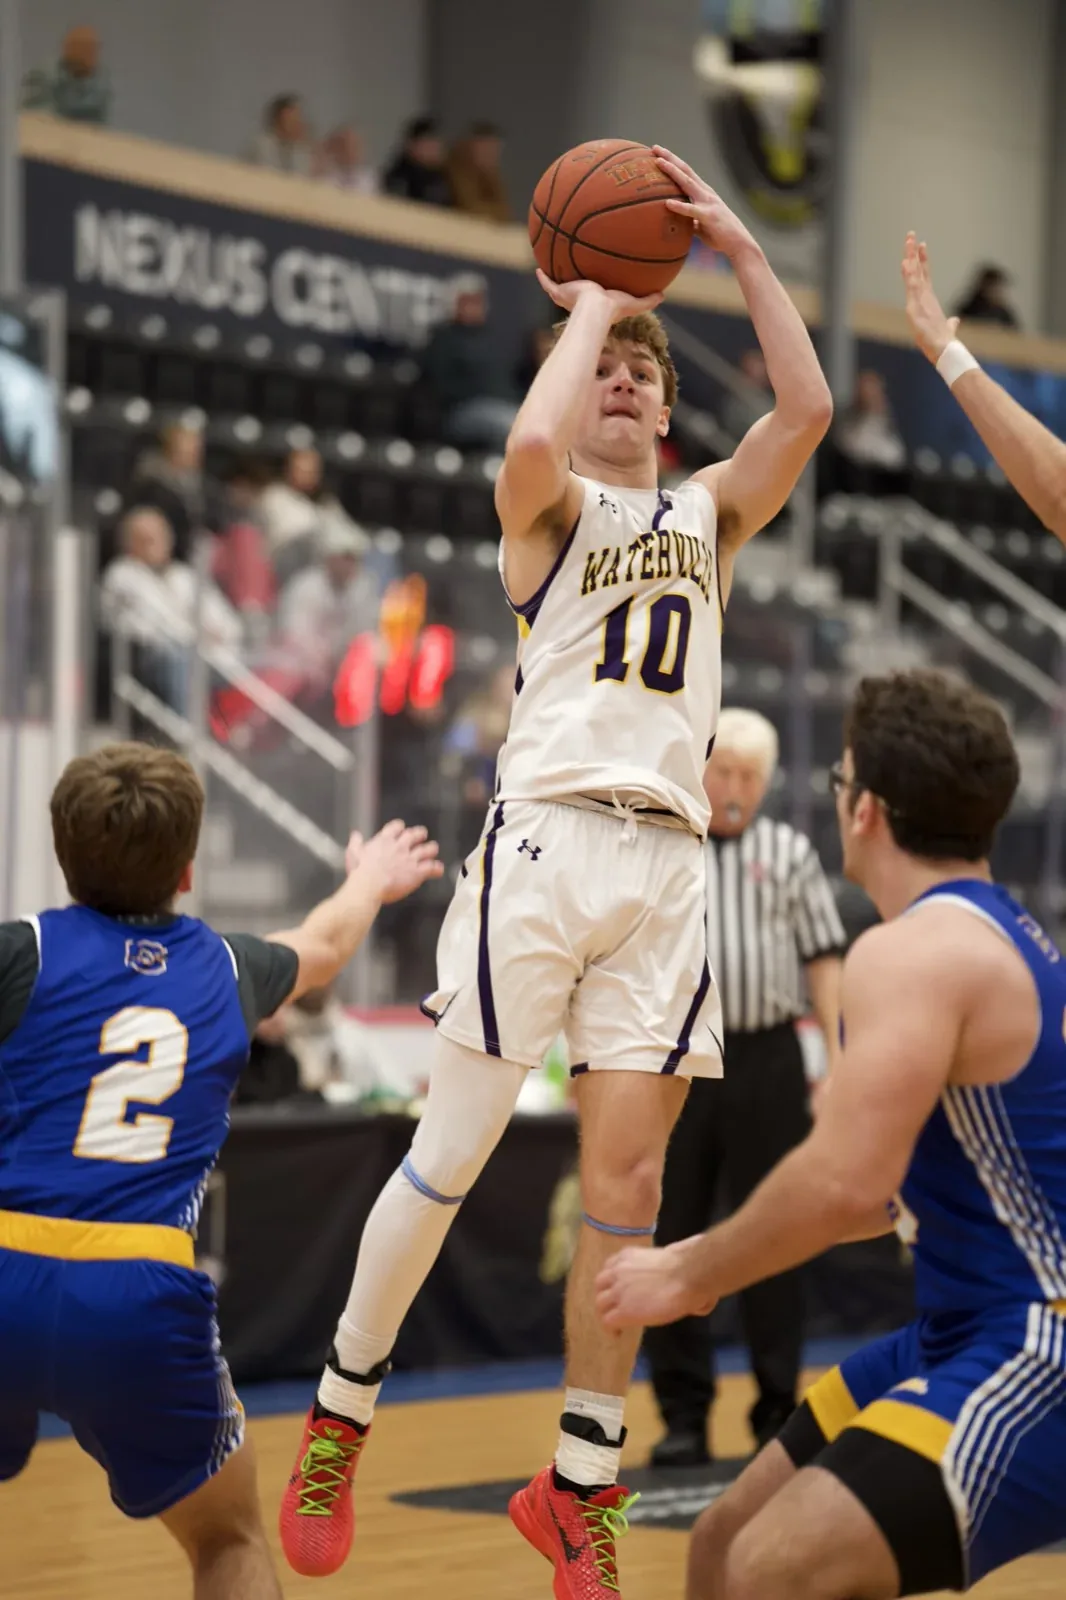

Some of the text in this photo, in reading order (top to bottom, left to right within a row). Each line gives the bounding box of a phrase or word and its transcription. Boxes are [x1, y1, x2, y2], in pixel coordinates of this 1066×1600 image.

[74, 203, 268, 317] NEXUS
[592, 592, 692, 697] 10
[73, 1005, 189, 1164] 2
